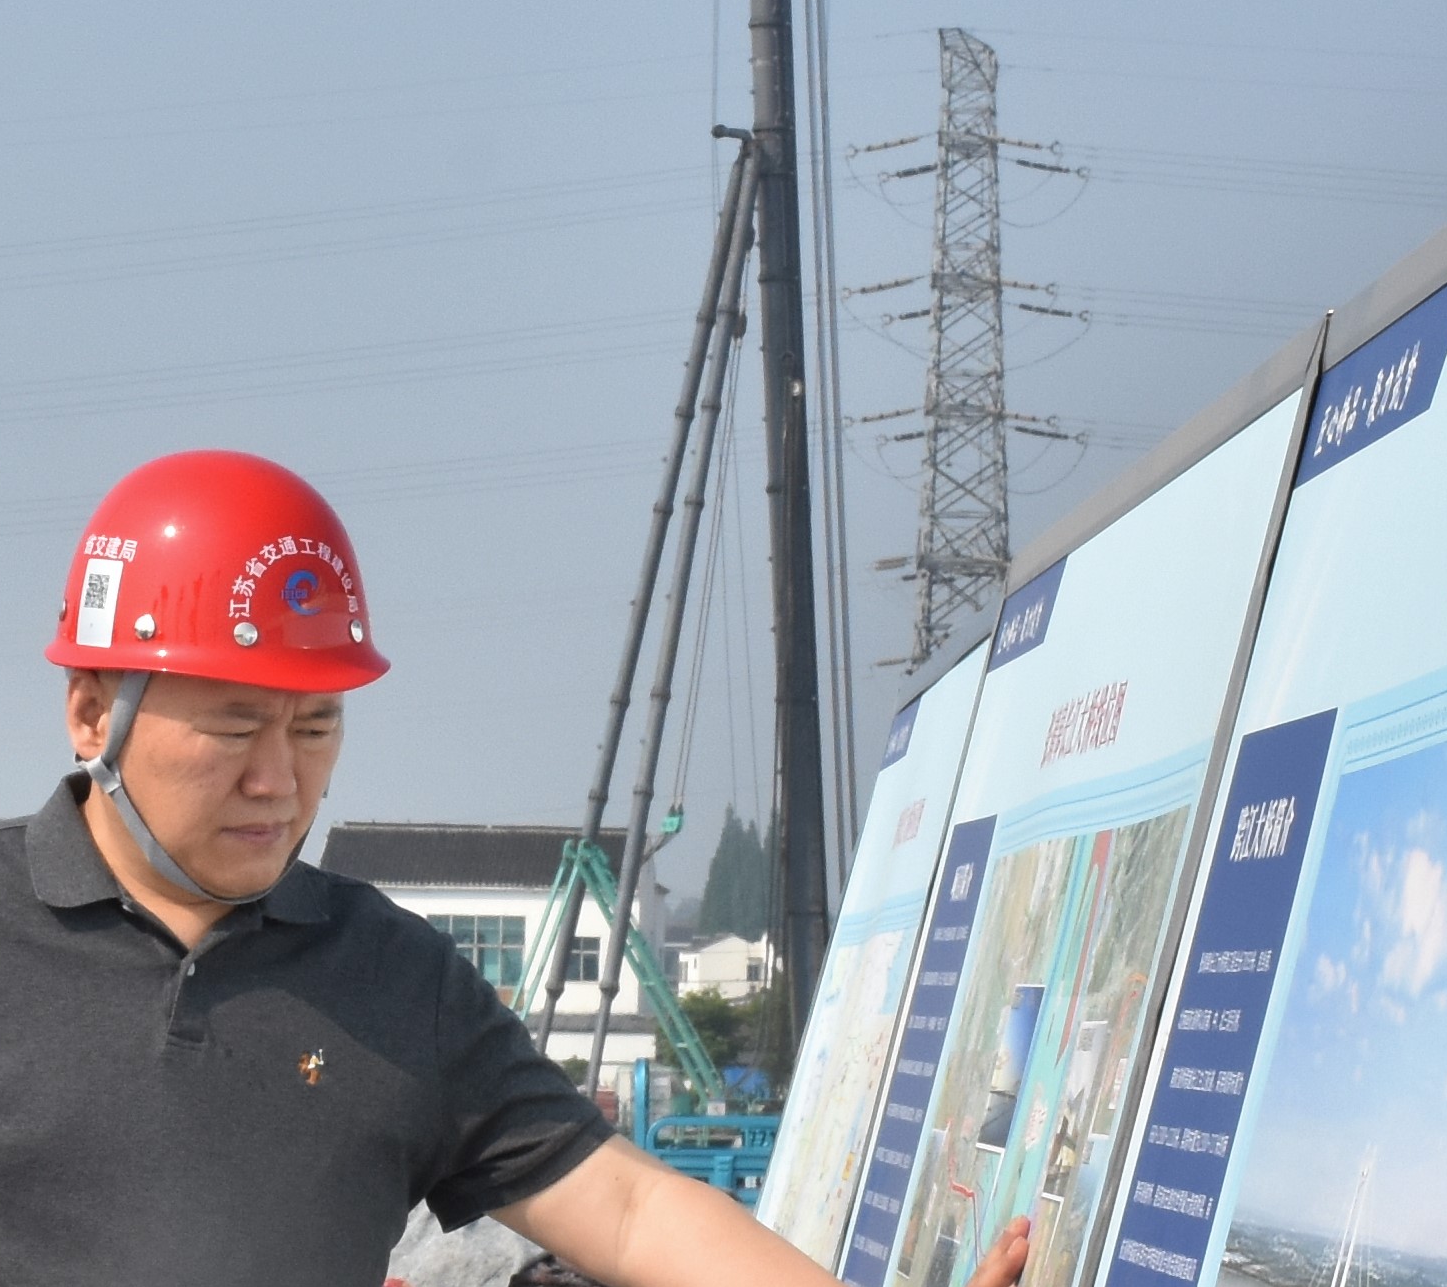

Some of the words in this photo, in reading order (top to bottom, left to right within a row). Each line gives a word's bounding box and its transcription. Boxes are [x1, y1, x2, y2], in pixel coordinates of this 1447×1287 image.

[84, 534, 138, 563] 省交建局
[228, 535, 358, 618] 江苏省交通工程建设局
